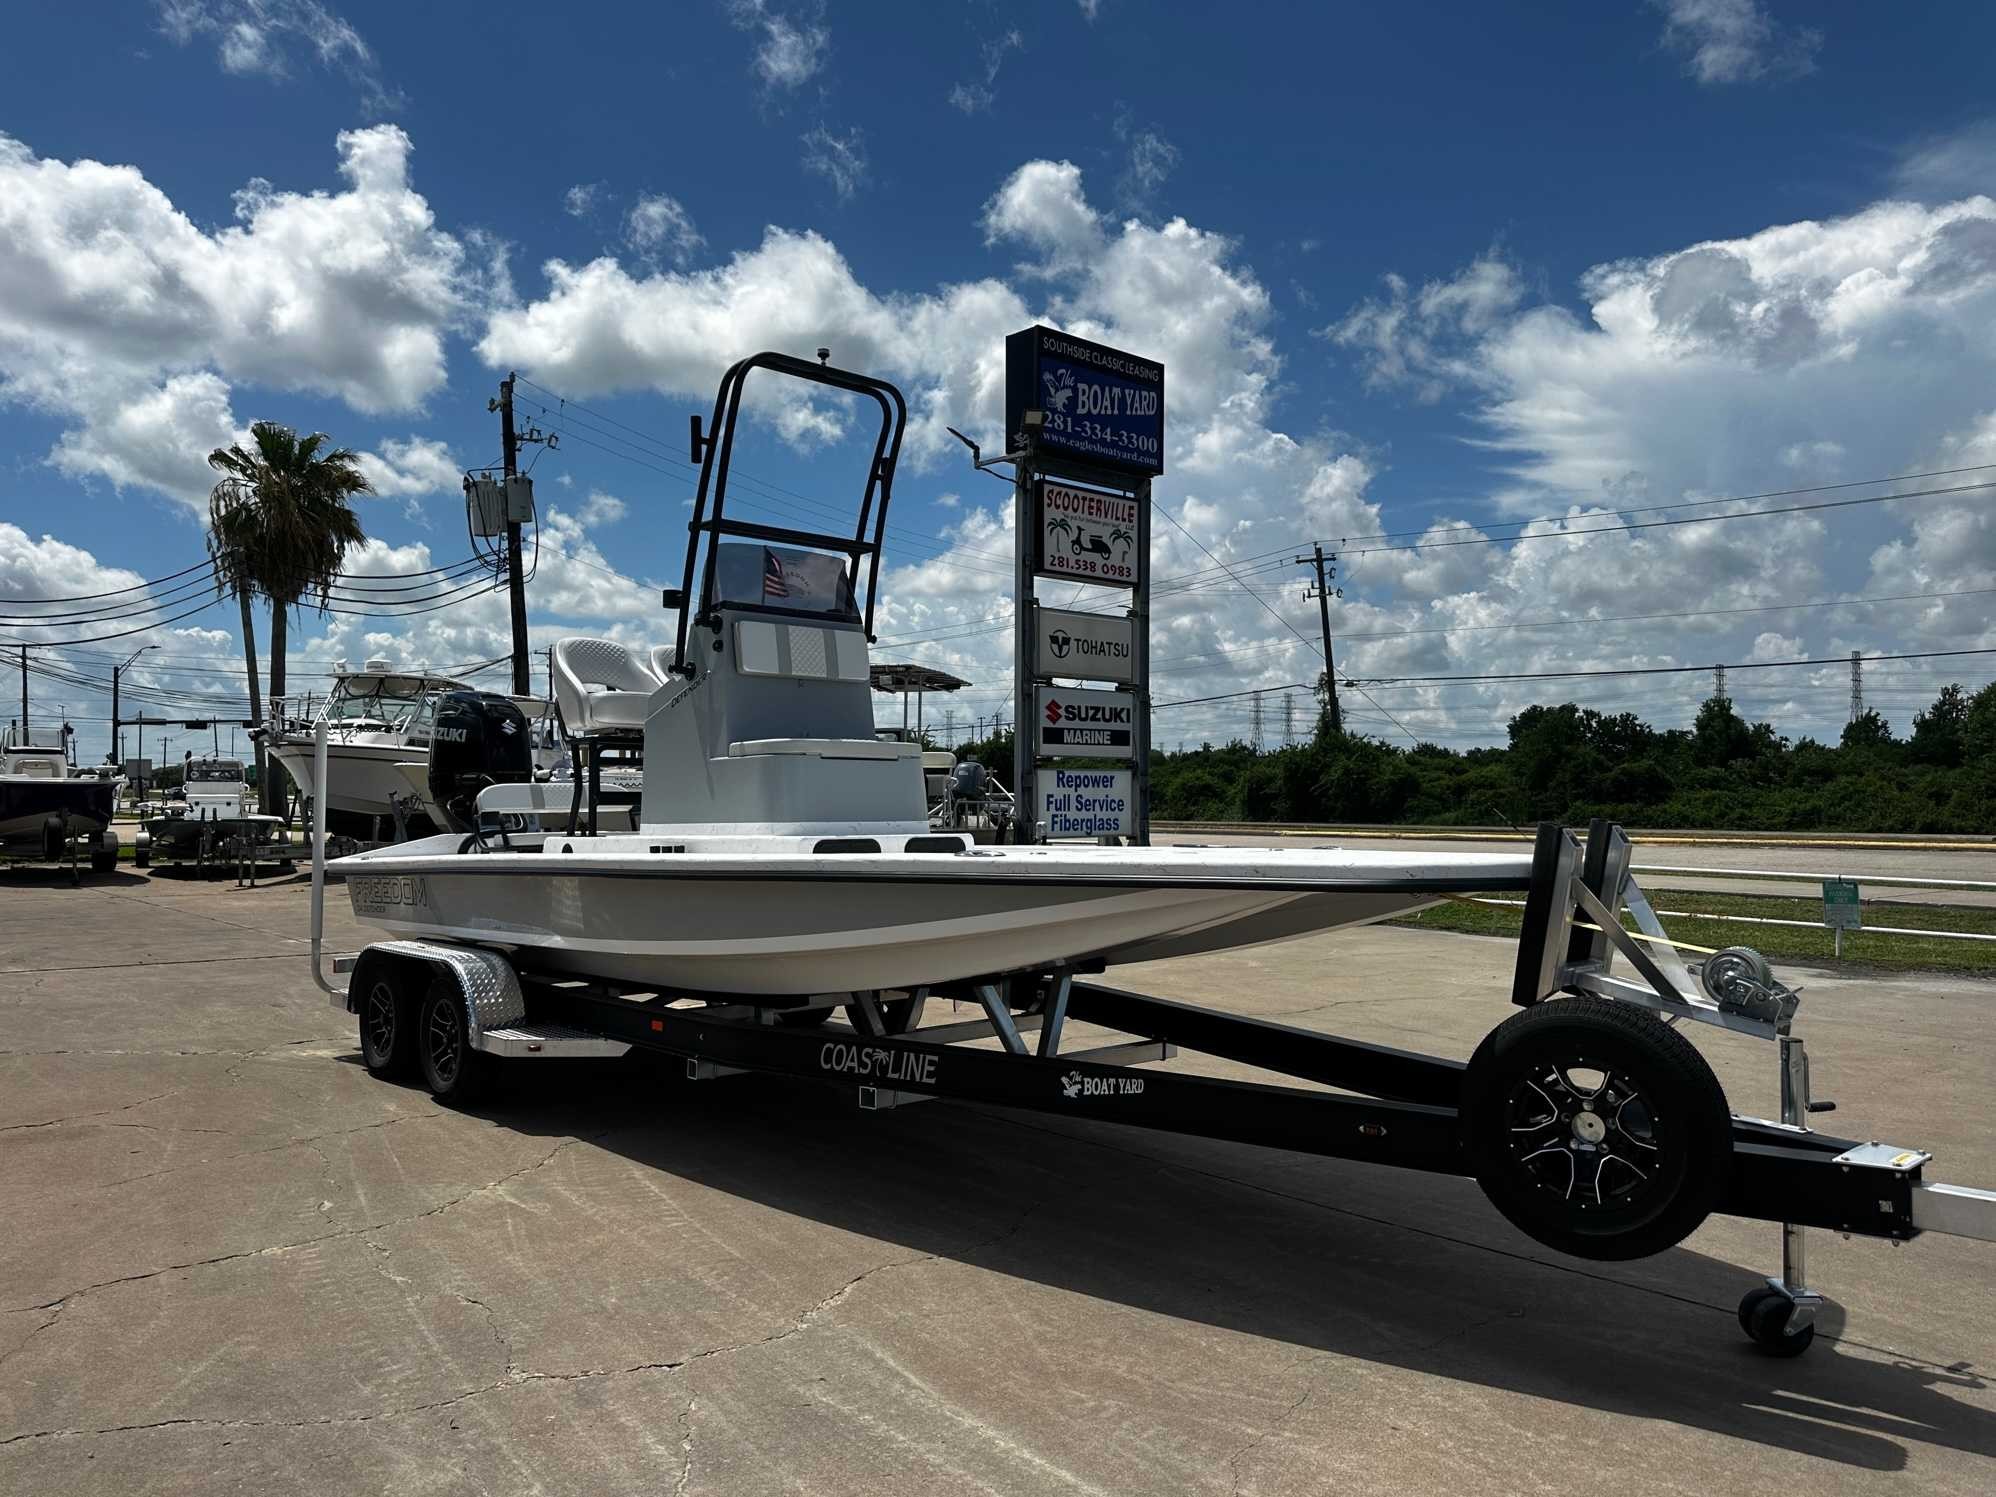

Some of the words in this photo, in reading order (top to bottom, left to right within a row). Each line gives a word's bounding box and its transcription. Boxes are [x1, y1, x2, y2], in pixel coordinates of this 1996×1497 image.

[1043, 336, 1091, 362] SOUTHSIDE
[1092, 352, 1125, 372] CLASSIC
[1125, 363, 1159, 382] LEASING
[1057, 369, 1076, 388] The
[1076, 383, 1121, 415] BOAT
[1124, 389, 1158, 416] YARD
[1042, 411, 1158, 454] 281-334-3300
[1043, 432, 1158, 466] www.eaglesboatyard.com
[1046, 488, 1135, 524] SCOOTERVILLE
[1049, 554, 1097, 573] 281.538
[1101, 563, 1132, 578] 0983
[1073, 638, 1129, 658] TOHATSU
[1063, 704, 1131, 724] SUZUKI
[1063, 729, 1112, 745] MARINE
[1056, 770, 1115, 793] Repower
[1046, 794, 1071, 812] Full
[1075, 794, 1125, 812] Service
[1050, 814, 1120, 836] Fiberglass
[353, 877, 427, 907] FREEDOM
[1069, 1070, 1083, 1083] The
[1082, 1077, 1117, 1096] BOAT
[1118, 1078, 1145, 1095] YARD
